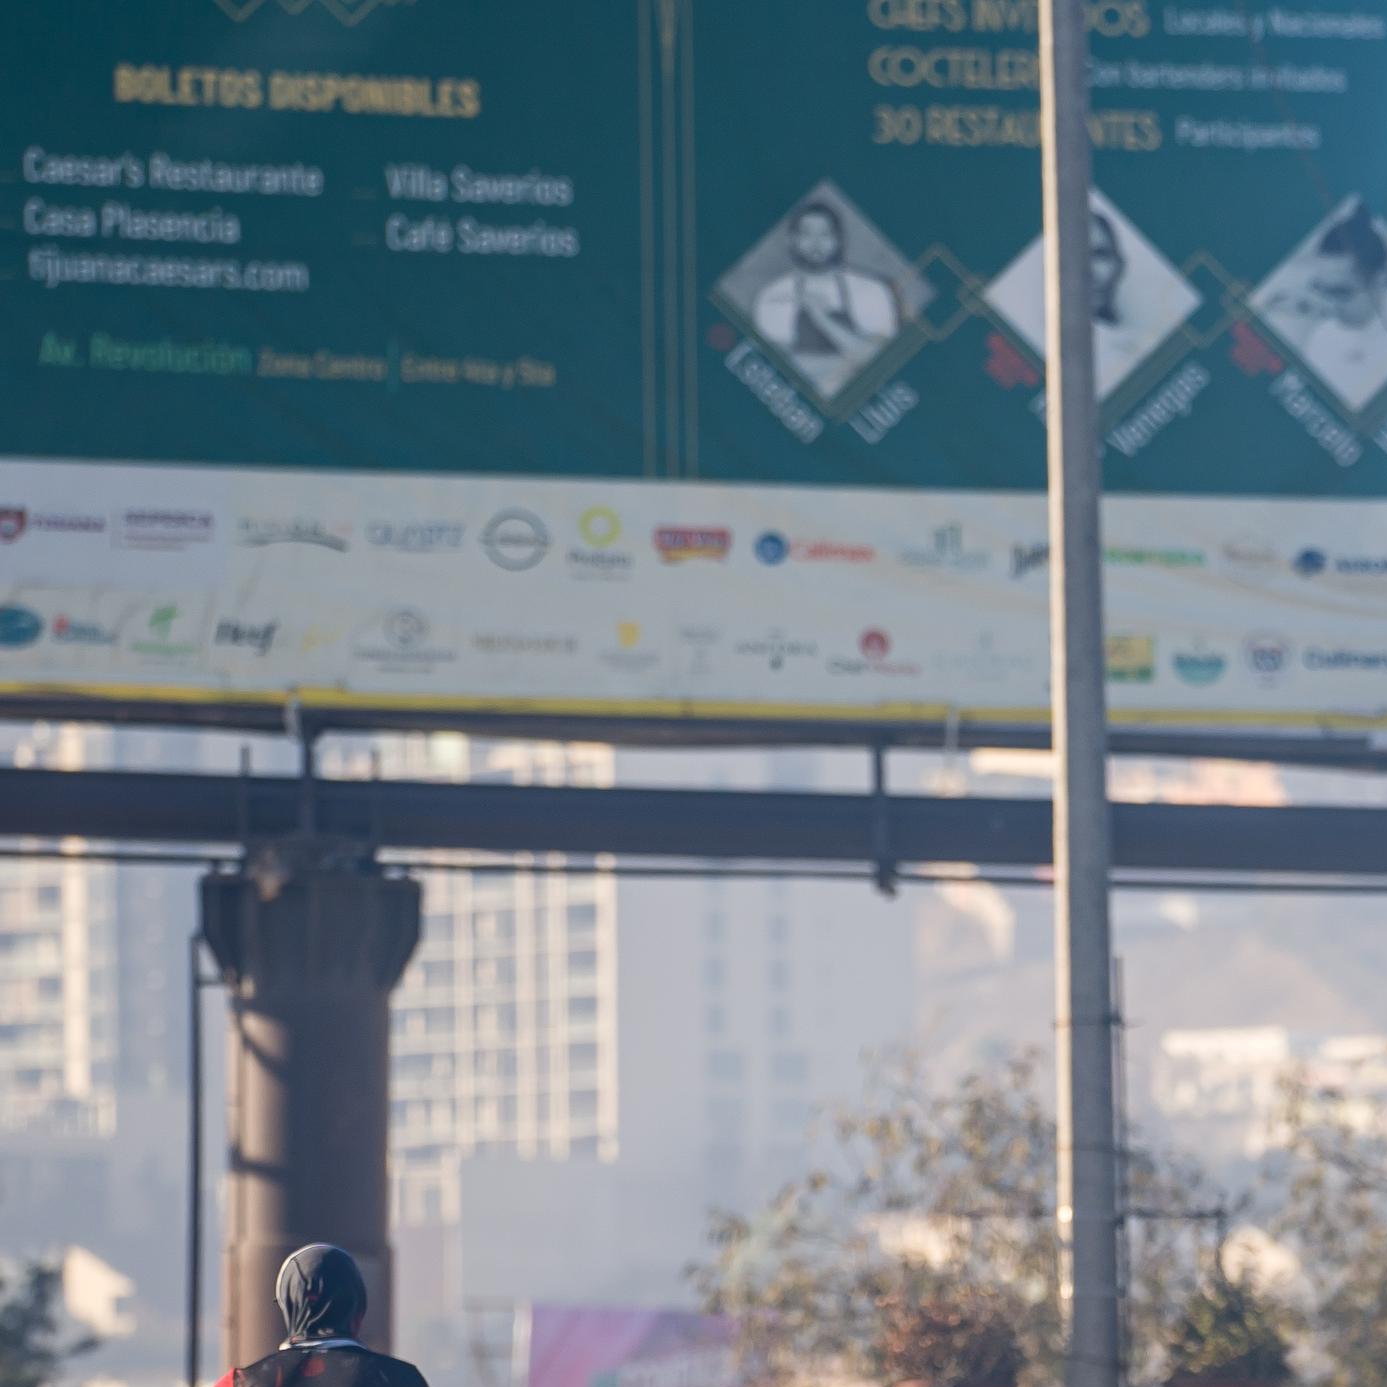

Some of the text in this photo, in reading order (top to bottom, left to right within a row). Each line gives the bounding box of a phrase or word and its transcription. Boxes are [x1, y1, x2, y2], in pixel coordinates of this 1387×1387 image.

[115, 64, 481, 119] BOLETOS DISPONIBLES
[872, 103, 924, 146] 30
[23, 147, 324, 197] Caesar's Restaurante
[385, 163, 574, 206] Villa Saverios
[24, 197, 241, 244] Casa Plasencia
[457, 215, 580, 257] Saverios
[28, 245, 309, 291] tijuanacaesars.com
